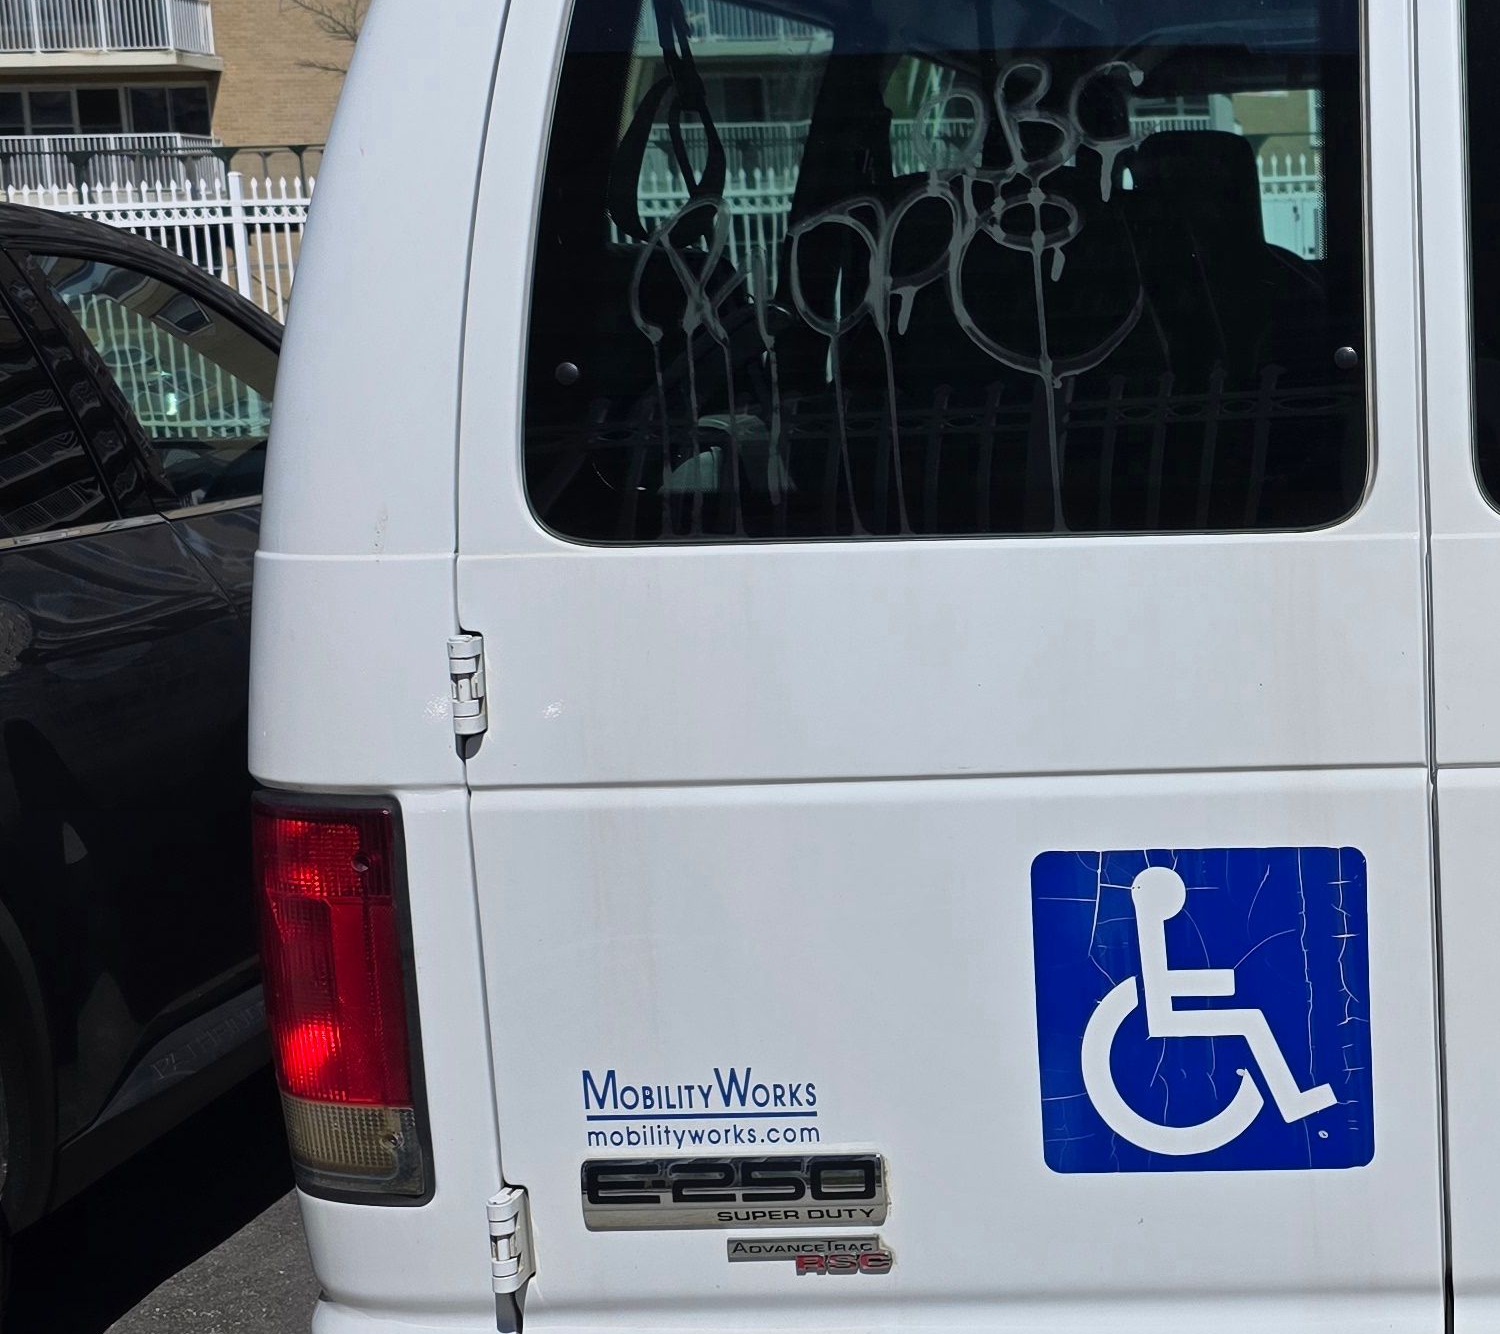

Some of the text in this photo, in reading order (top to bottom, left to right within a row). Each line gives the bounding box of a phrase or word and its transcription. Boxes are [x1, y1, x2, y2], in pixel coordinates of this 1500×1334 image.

[587, 1124, 820, 1149] mobilityworks.com
[587, 1159, 876, 1204] E-250
[717, 1207, 875, 1222] SUPER DUTY
[796, 1252, 891, 1275] RSC
